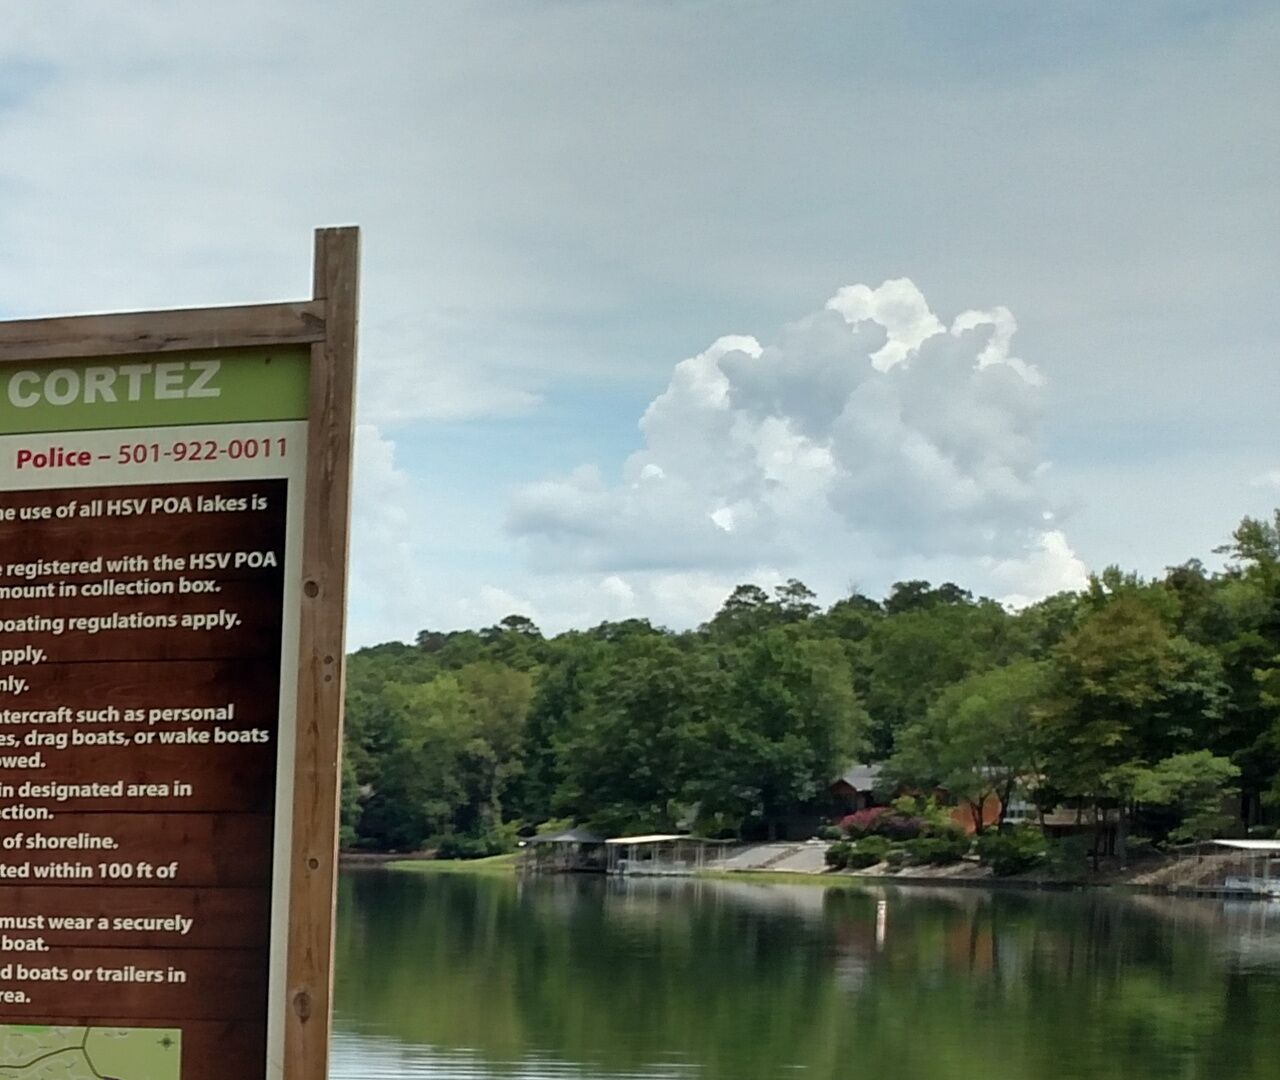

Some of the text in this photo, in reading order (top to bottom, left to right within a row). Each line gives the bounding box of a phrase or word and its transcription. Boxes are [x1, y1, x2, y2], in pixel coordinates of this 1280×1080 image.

[7, 360, 222, 407] CORTEZ
[17, 447, 91, 470] Police
[118, 437, 288, 464] 501-922-0011
[20, 507, 52, 519] use
[56, 501, 77, 518] of
[80, 500, 102, 517] all
[107, 499, 147, 515] HSV
[151, 497, 192, 514] POA
[198, 495, 246, 512] lakes
[252, 494, 266, 510] is
[7, 557, 102, 579] registered
[106, 555, 148, 572] with
[153, 554, 185, 570] the
[190, 553, 230, 569] HSV
[235, 552, 276, 568] POA
[59, 581, 76, 596] in
[81, 578, 174, 596] collection
[179, 577, 220, 592] box.
[69, 612, 177, 633] regulations
[182, 610, 241, 630] apply.
[76, 706, 120, 722] such
[124, 710, 145, 721] as
[149, 704, 233, 724] personal
[24, 730, 68, 749] drag
[72, 729, 130, 746] boats,
[134, 732, 156, 744] or
[159, 728, 210, 743] wake
[214, 727, 268, 742] boats
[18, 781, 123, 800] designated
[127, 784, 168, 796] area
[174, 781, 192, 796] in
[3, 833, 23, 848] of
[26, 833, 118, 848] shoreline.
[34, 862, 92, 878] within
[98, 863, 132, 878] 100
[136, 862, 152, 878] ft
[156, 862, 178, 878] of
[48, 918, 94, 929] wear
[98, 918, 108, 929] a
[113, 915, 192, 934] securely
[2, 935, 49, 951] boat.
[17, 964, 68, 980] boats
[72, 969, 93, 980] or
[96, 966, 164, 982] trailers
[168, 967, 186, 982] in
